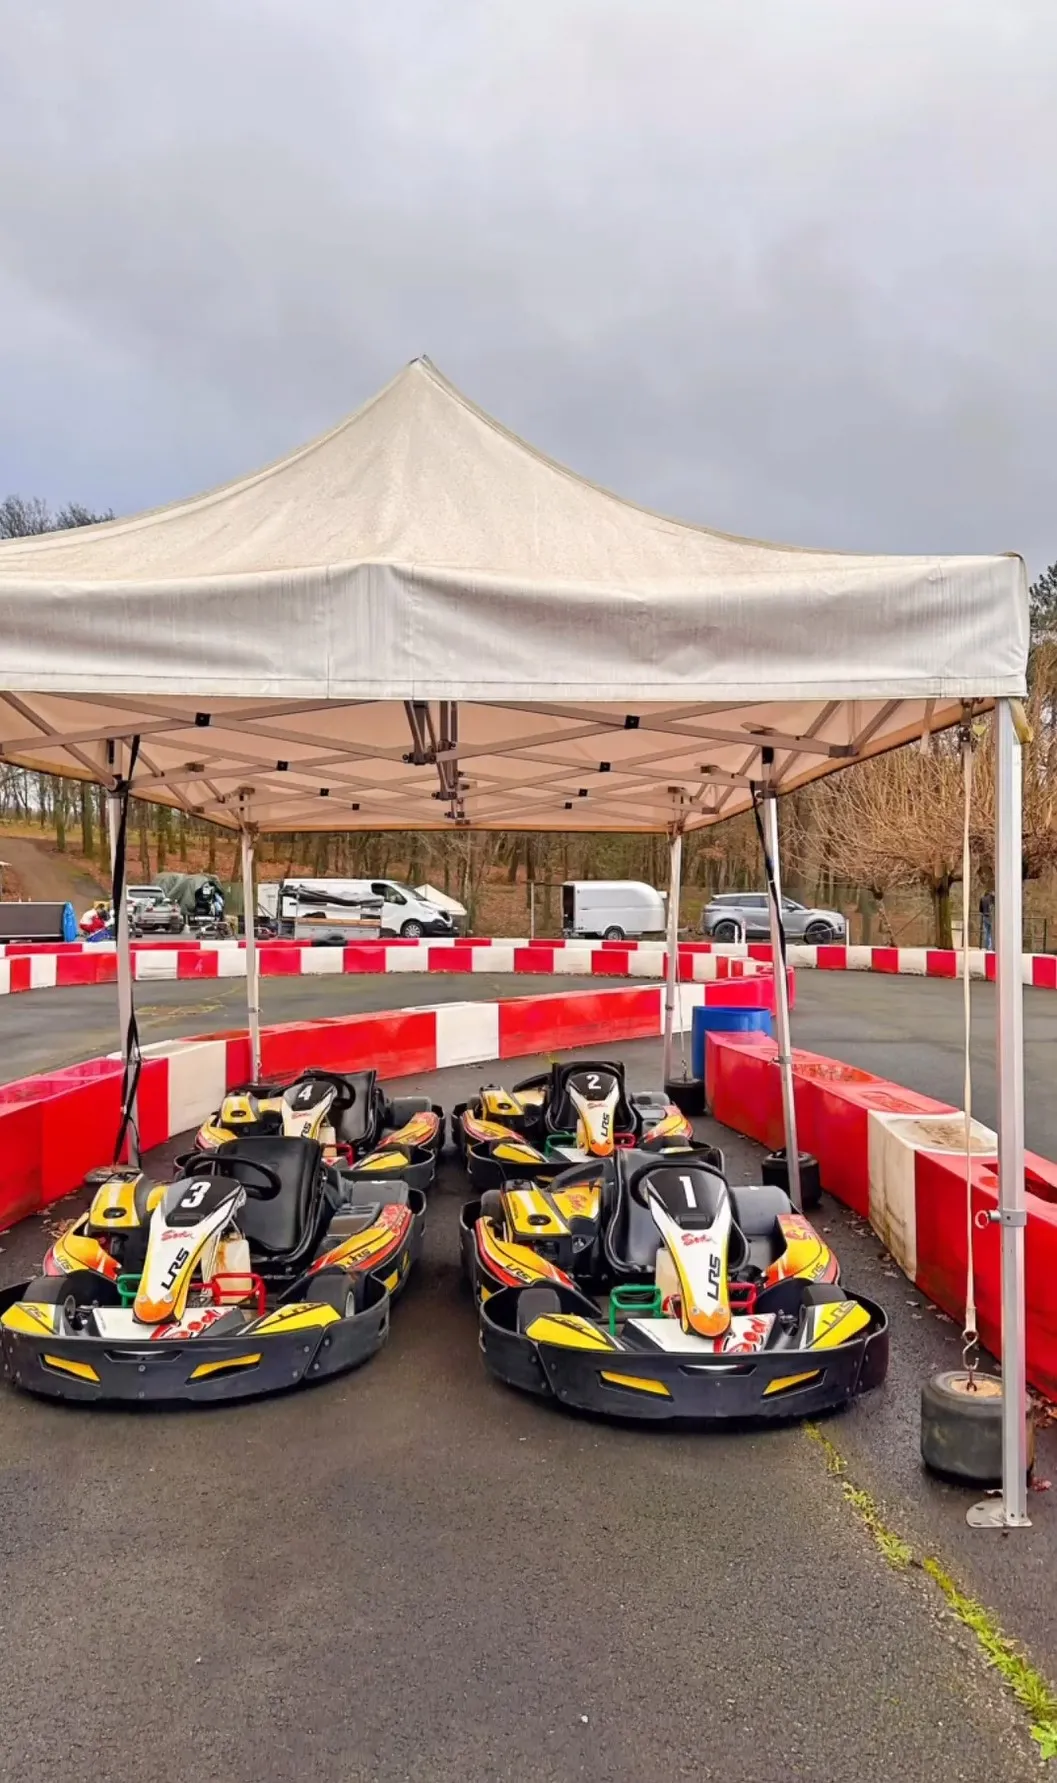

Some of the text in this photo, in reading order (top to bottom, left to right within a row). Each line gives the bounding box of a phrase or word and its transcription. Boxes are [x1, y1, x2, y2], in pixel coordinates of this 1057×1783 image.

[298, 1084, 313, 1101] 4
[586, 1074, 601, 1090] 2
[600, 1112, 610, 1138] LRS
[180, 1181, 212, 1208] 3
[678, 1176, 697, 1208] 1
[161, 1248, 189, 1290] LRS
[707, 1254, 721, 1300] LRS
